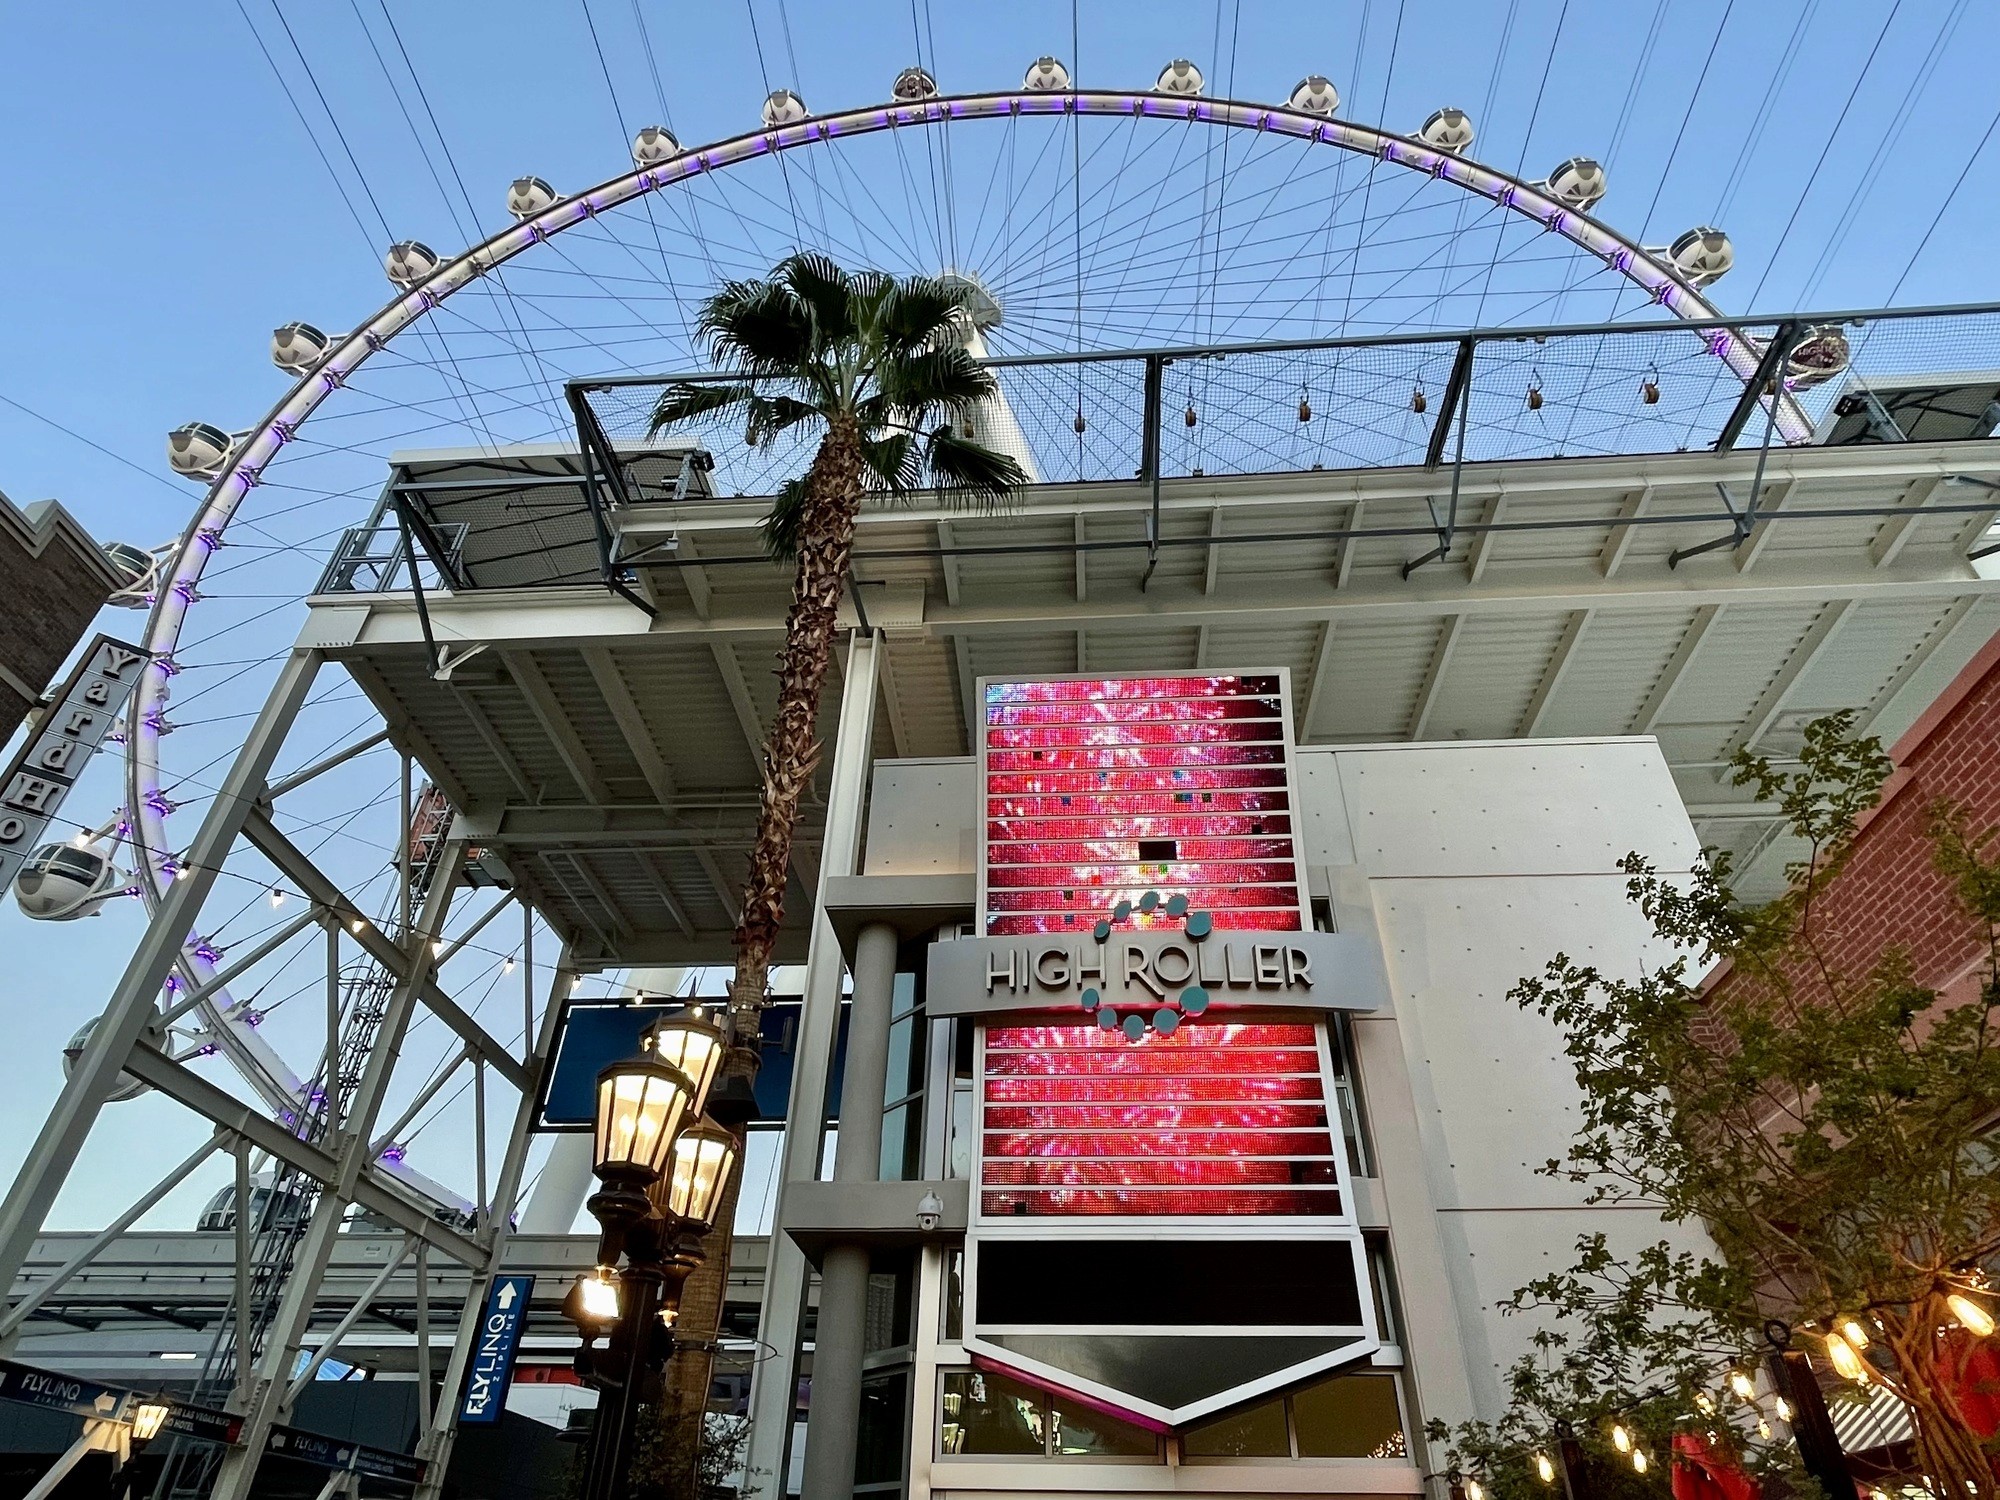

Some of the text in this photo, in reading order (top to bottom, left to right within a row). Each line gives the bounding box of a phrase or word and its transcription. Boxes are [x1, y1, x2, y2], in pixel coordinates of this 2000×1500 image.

[0, 645, 140, 868] Yard Ho
[986, 942, 1314, 1001] HIGH ROLLER
[466, 1313, 507, 1415] FLYLINQ
[493, 1314, 515, 1382] ZIPLINE
[21, 1373, 80, 1401] FLYLINQ
[173, 1419, 195, 1432] HOTEL
[195, 1412, 215, 1423] VEGAS
